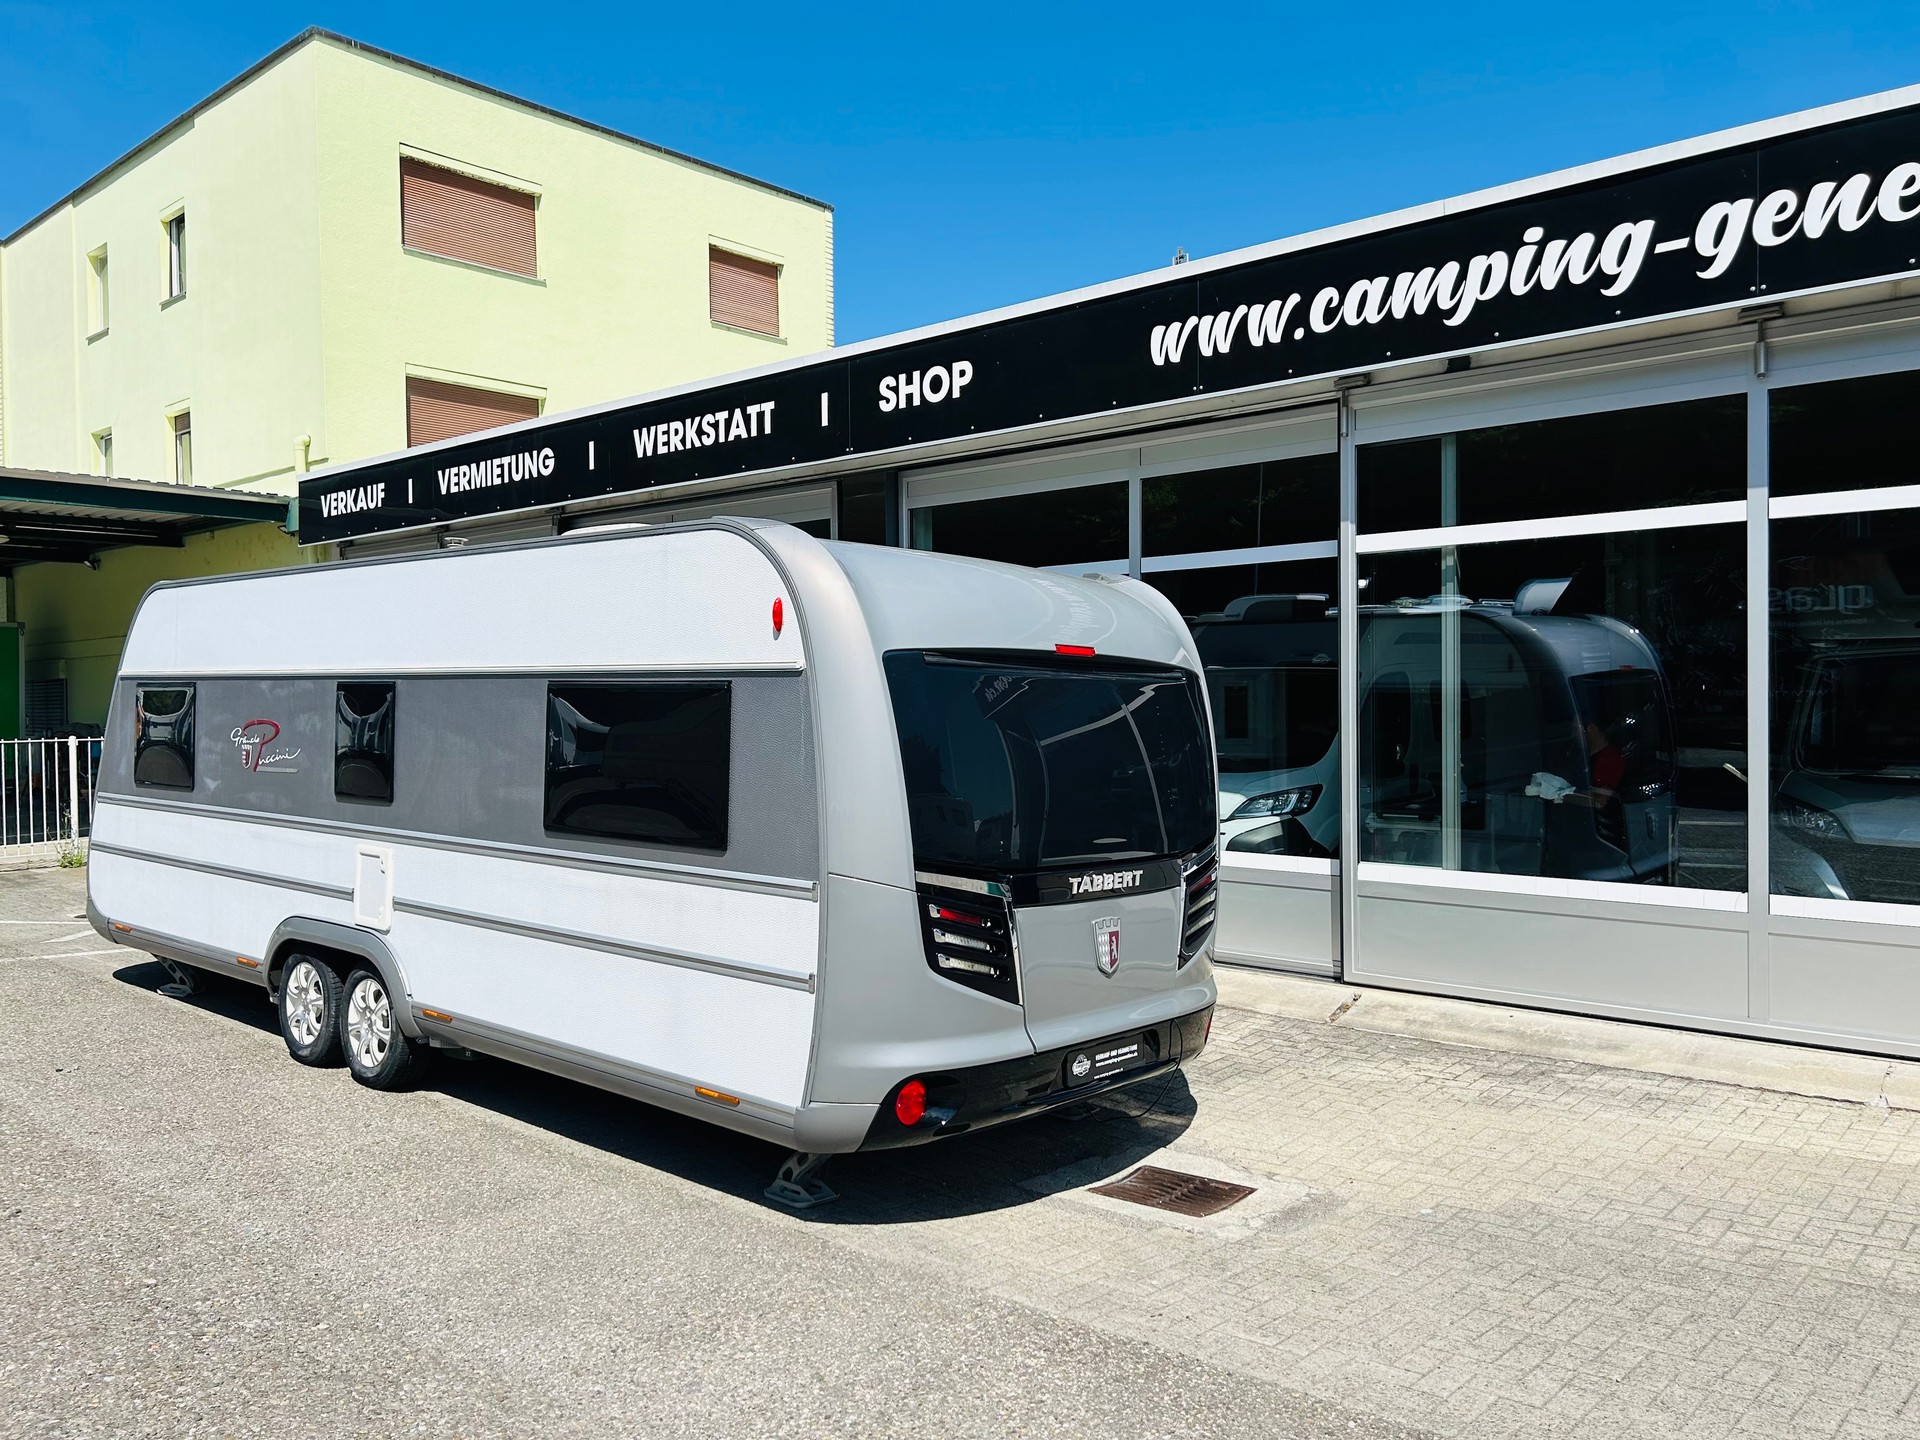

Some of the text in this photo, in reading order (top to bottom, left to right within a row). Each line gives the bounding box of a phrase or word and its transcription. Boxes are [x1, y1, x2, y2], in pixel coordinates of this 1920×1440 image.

[1150, 161, 1920, 366] www.camping-gene
[320, 482, 385, 518] VERKAUF
[437, 447, 555, 495] VERMIETUNG
[633, 400, 775, 458] WERKSTATT
[878, 360, 973, 413] SHOP
[241, 718, 301, 773] Puccini
[1069, 869, 1144, 894] TABBERT
